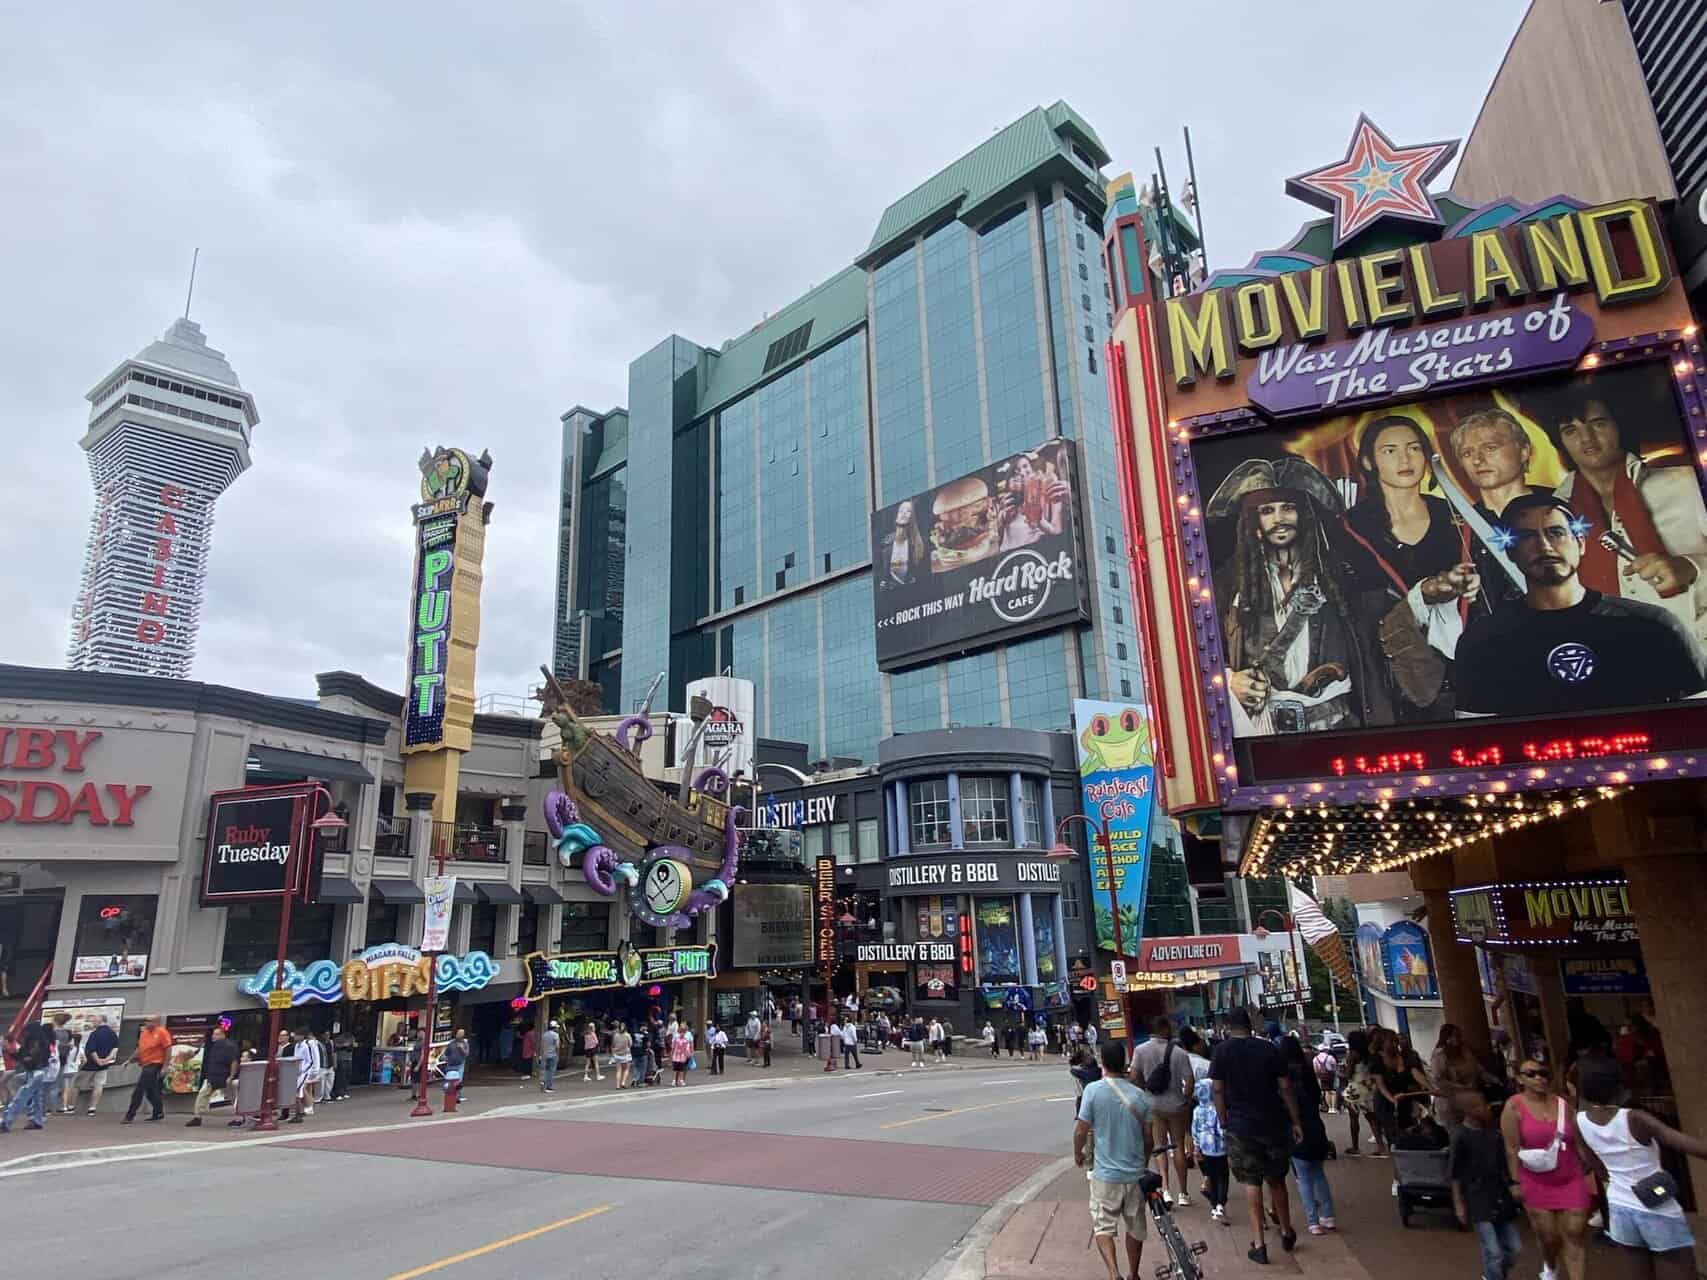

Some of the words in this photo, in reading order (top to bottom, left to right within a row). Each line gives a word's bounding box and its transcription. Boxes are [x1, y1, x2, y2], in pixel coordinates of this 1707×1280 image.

[1165, 198, 1672, 388] MOVIELAND
[1259, 343, 1335, 385] Wax
[1344, 317, 1514, 369] Museum
[1524, 293, 1573, 342] of
[1315, 366, 1388, 406] The
[1397, 346, 1513, 393] Stars
[136, 484, 184, 644] CASINO
[969, 566, 1020, 603] Hard
[1021, 551, 1073, 590] Rock
[896, 606, 921, 625] ROCK
[921, 600, 943, 617] THIS
[944, 592, 964, 609] WAY
[1008, 594, 1034, 610] CAFE
[414, 550, 453, 717] PUTT
[704, 723, 742, 733] AGARA
[1086, 775, 1148, 802] Rainforest
[757, 795, 836, 828] DSTILLERY
[225, 824, 272, 847] Ruby
[1108, 830, 1142, 840] WILD
[217, 842, 291, 864] Tuesday
[1111, 855, 1139, 864] SHOP
[889, 864, 946, 886] DISTILLERY
[951, 864, 962, 882] &
[966, 863, 999, 882] BBQ
[366, 949, 397, 964] NIAGARA
[397, 950, 416, 962] FALLS
[674, 951, 709, 975] PUTT
[858, 944, 916, 960] DISTILLERY
[919, 944, 928, 960] &
[930, 944, 955, 960] BBQ
[1151, 944, 1205, 960] ADVENTURE
[1206, 943, 1223, 957] CITY
[1079, 976, 1097, 991] 4D
[1135, 971, 1174, 983] GAMES
